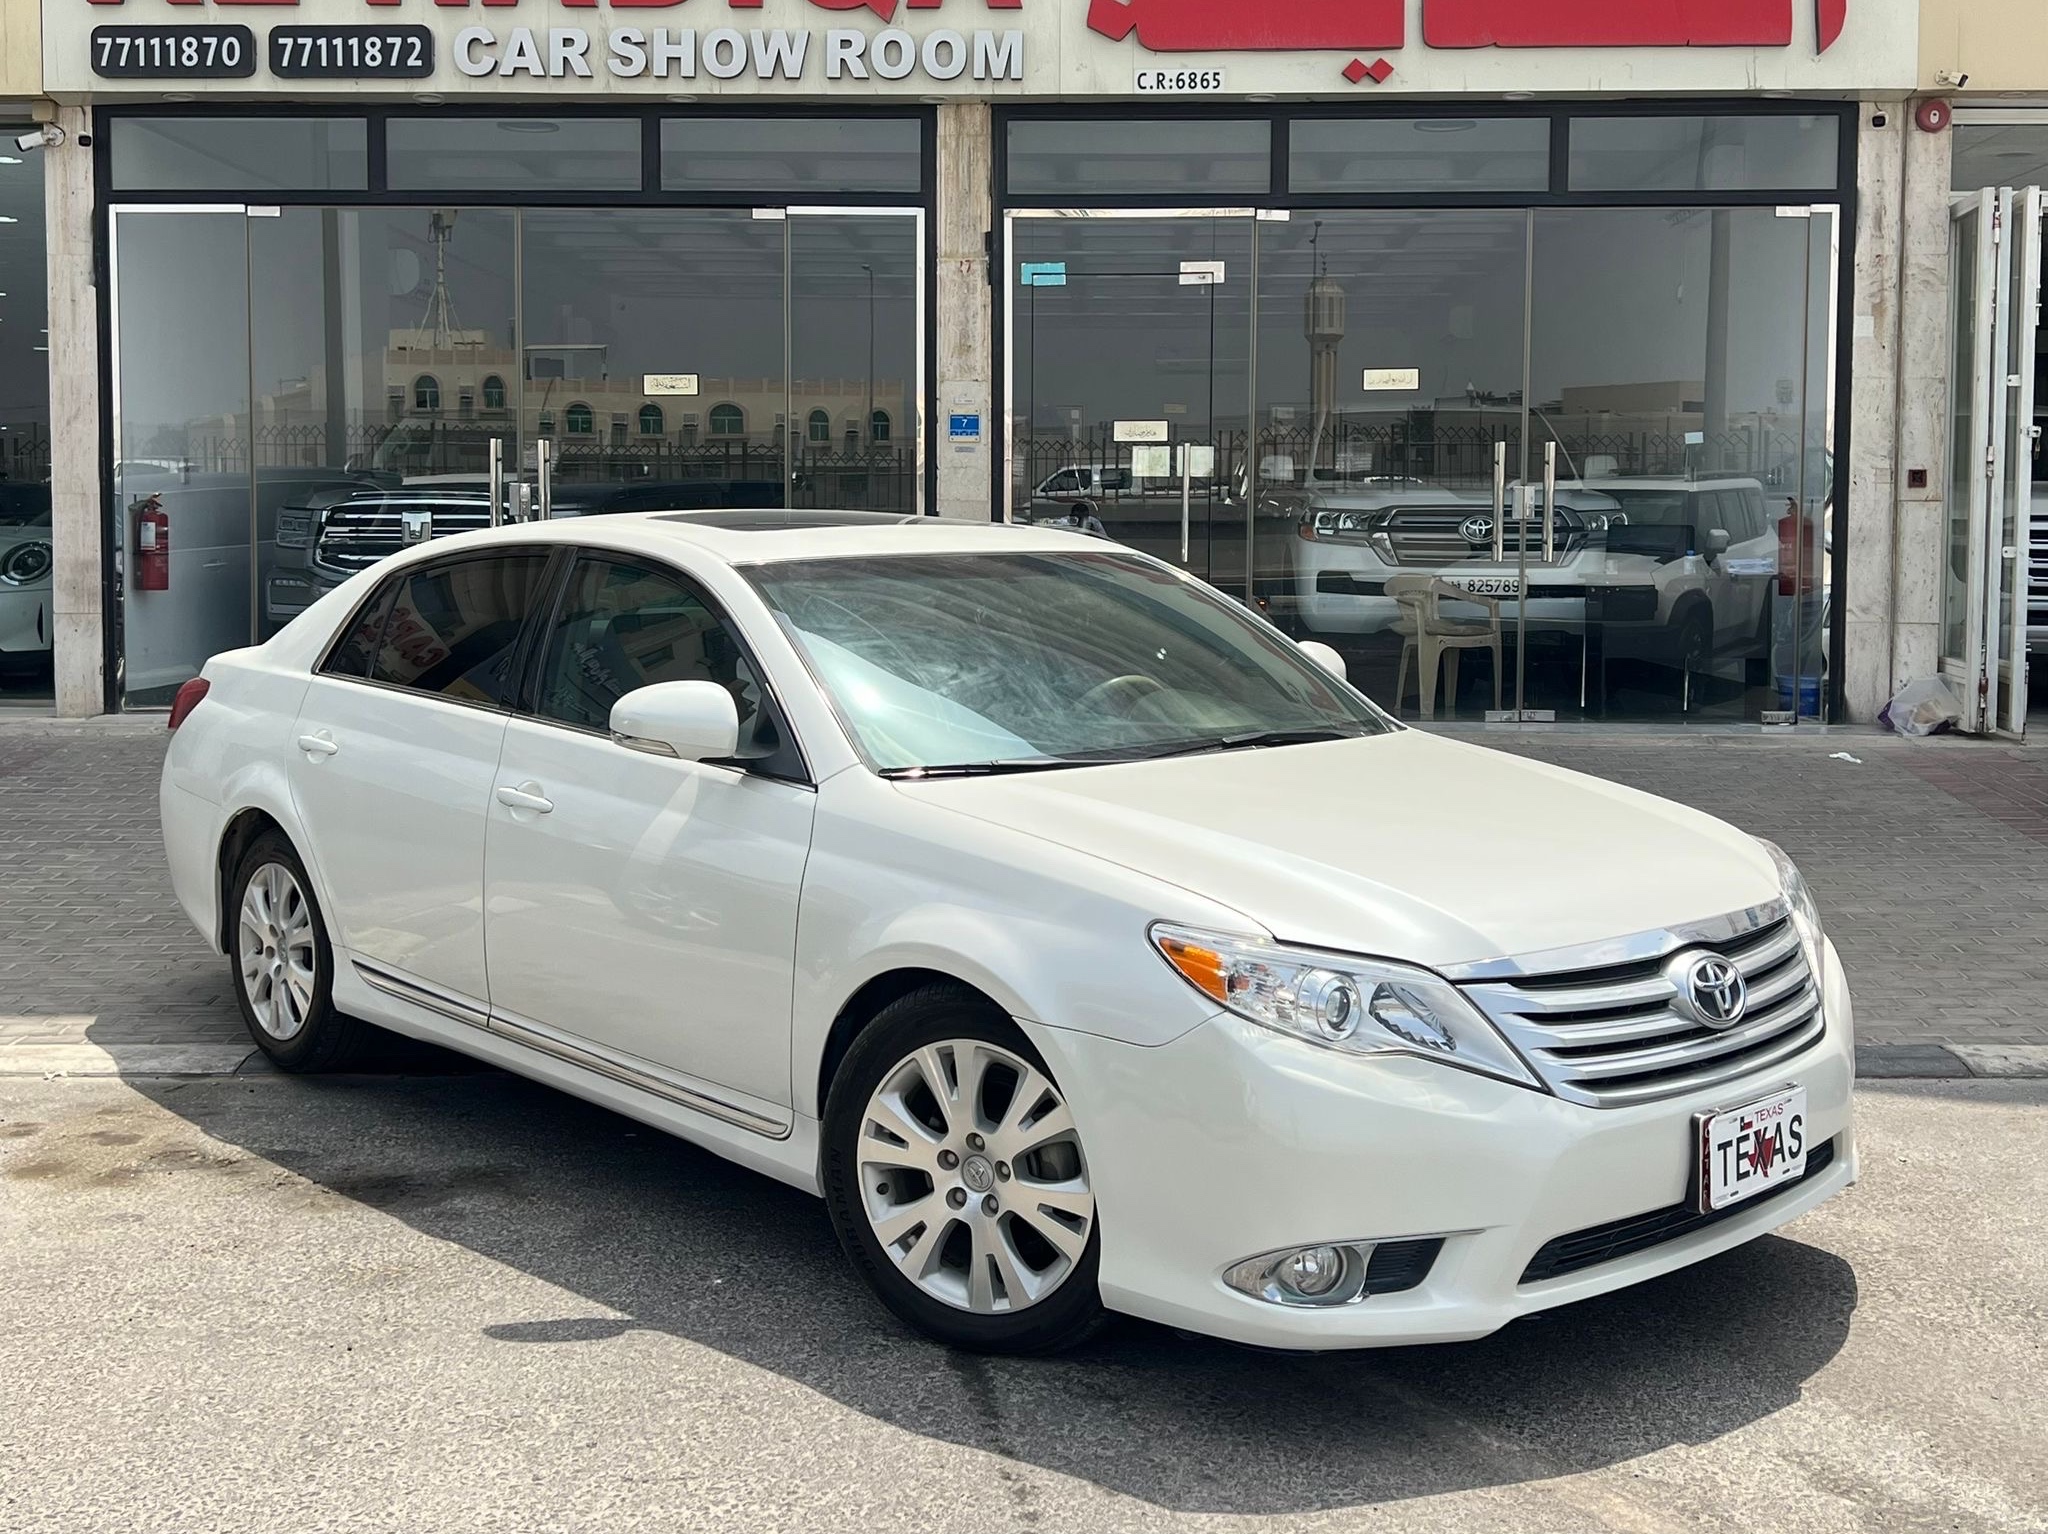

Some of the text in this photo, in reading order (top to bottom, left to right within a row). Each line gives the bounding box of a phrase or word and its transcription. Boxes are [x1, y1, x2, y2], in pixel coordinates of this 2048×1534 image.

[97, 36, 241, 69] 77111870
[277, 37, 423, 68] 77111872
[453, 27, 1024, 80] CAR SHOW ROOM
[1137, 72, 1221, 90] C.R:6865
[962, 419, 968, 428] 7
[1467, 579, 1520, 593] 825789
[1754, 1103, 1784, 1124] TEXAS
[1717, 1114, 1803, 1187] TEXAS
